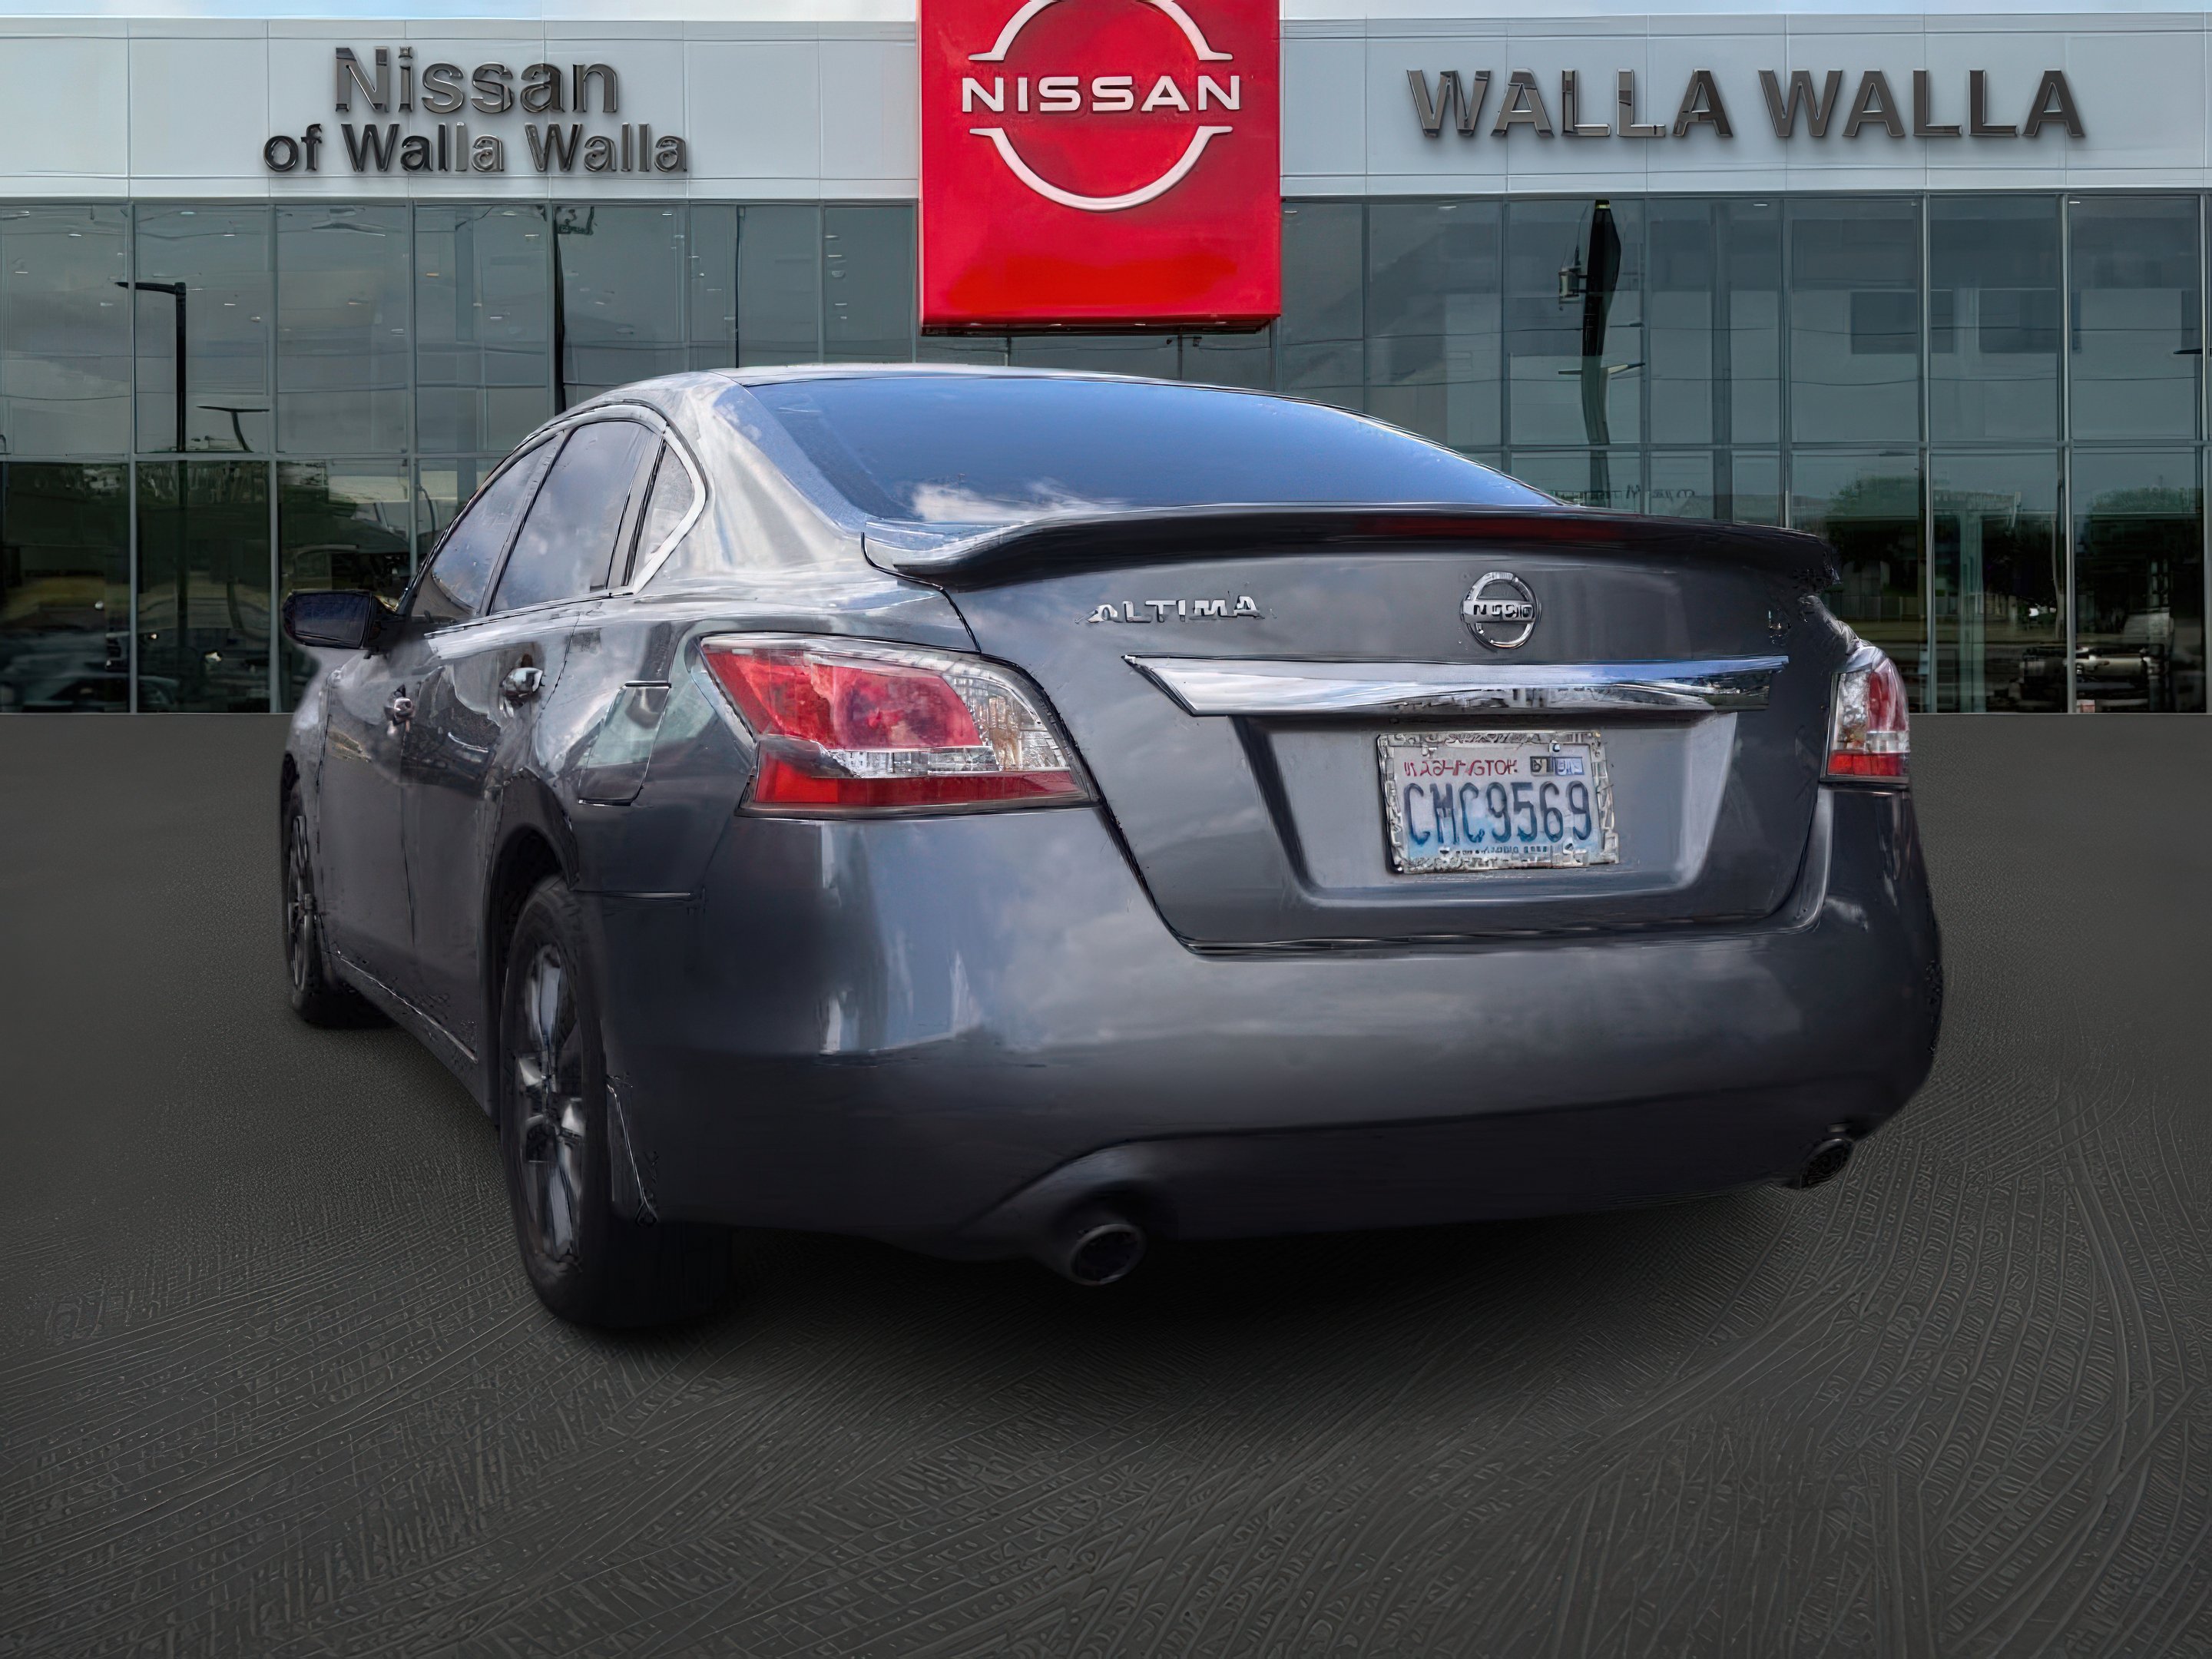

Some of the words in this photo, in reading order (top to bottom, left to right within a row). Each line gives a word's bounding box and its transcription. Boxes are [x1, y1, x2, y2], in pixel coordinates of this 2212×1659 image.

[335, 46, 618, 113] Nissan
[962, 75, 1240, 112] NISSAN
[1406, 68, 1734, 137] WALLA
[1758, 68, 2086, 137] WALLA
[263, 123, 323, 172] of
[341, 123, 504, 172] Walla
[524, 123, 688, 172] Walla
[1088, 595, 1262, 624] ALTIMA
[1404, 780, 1592, 845] CMC9569
